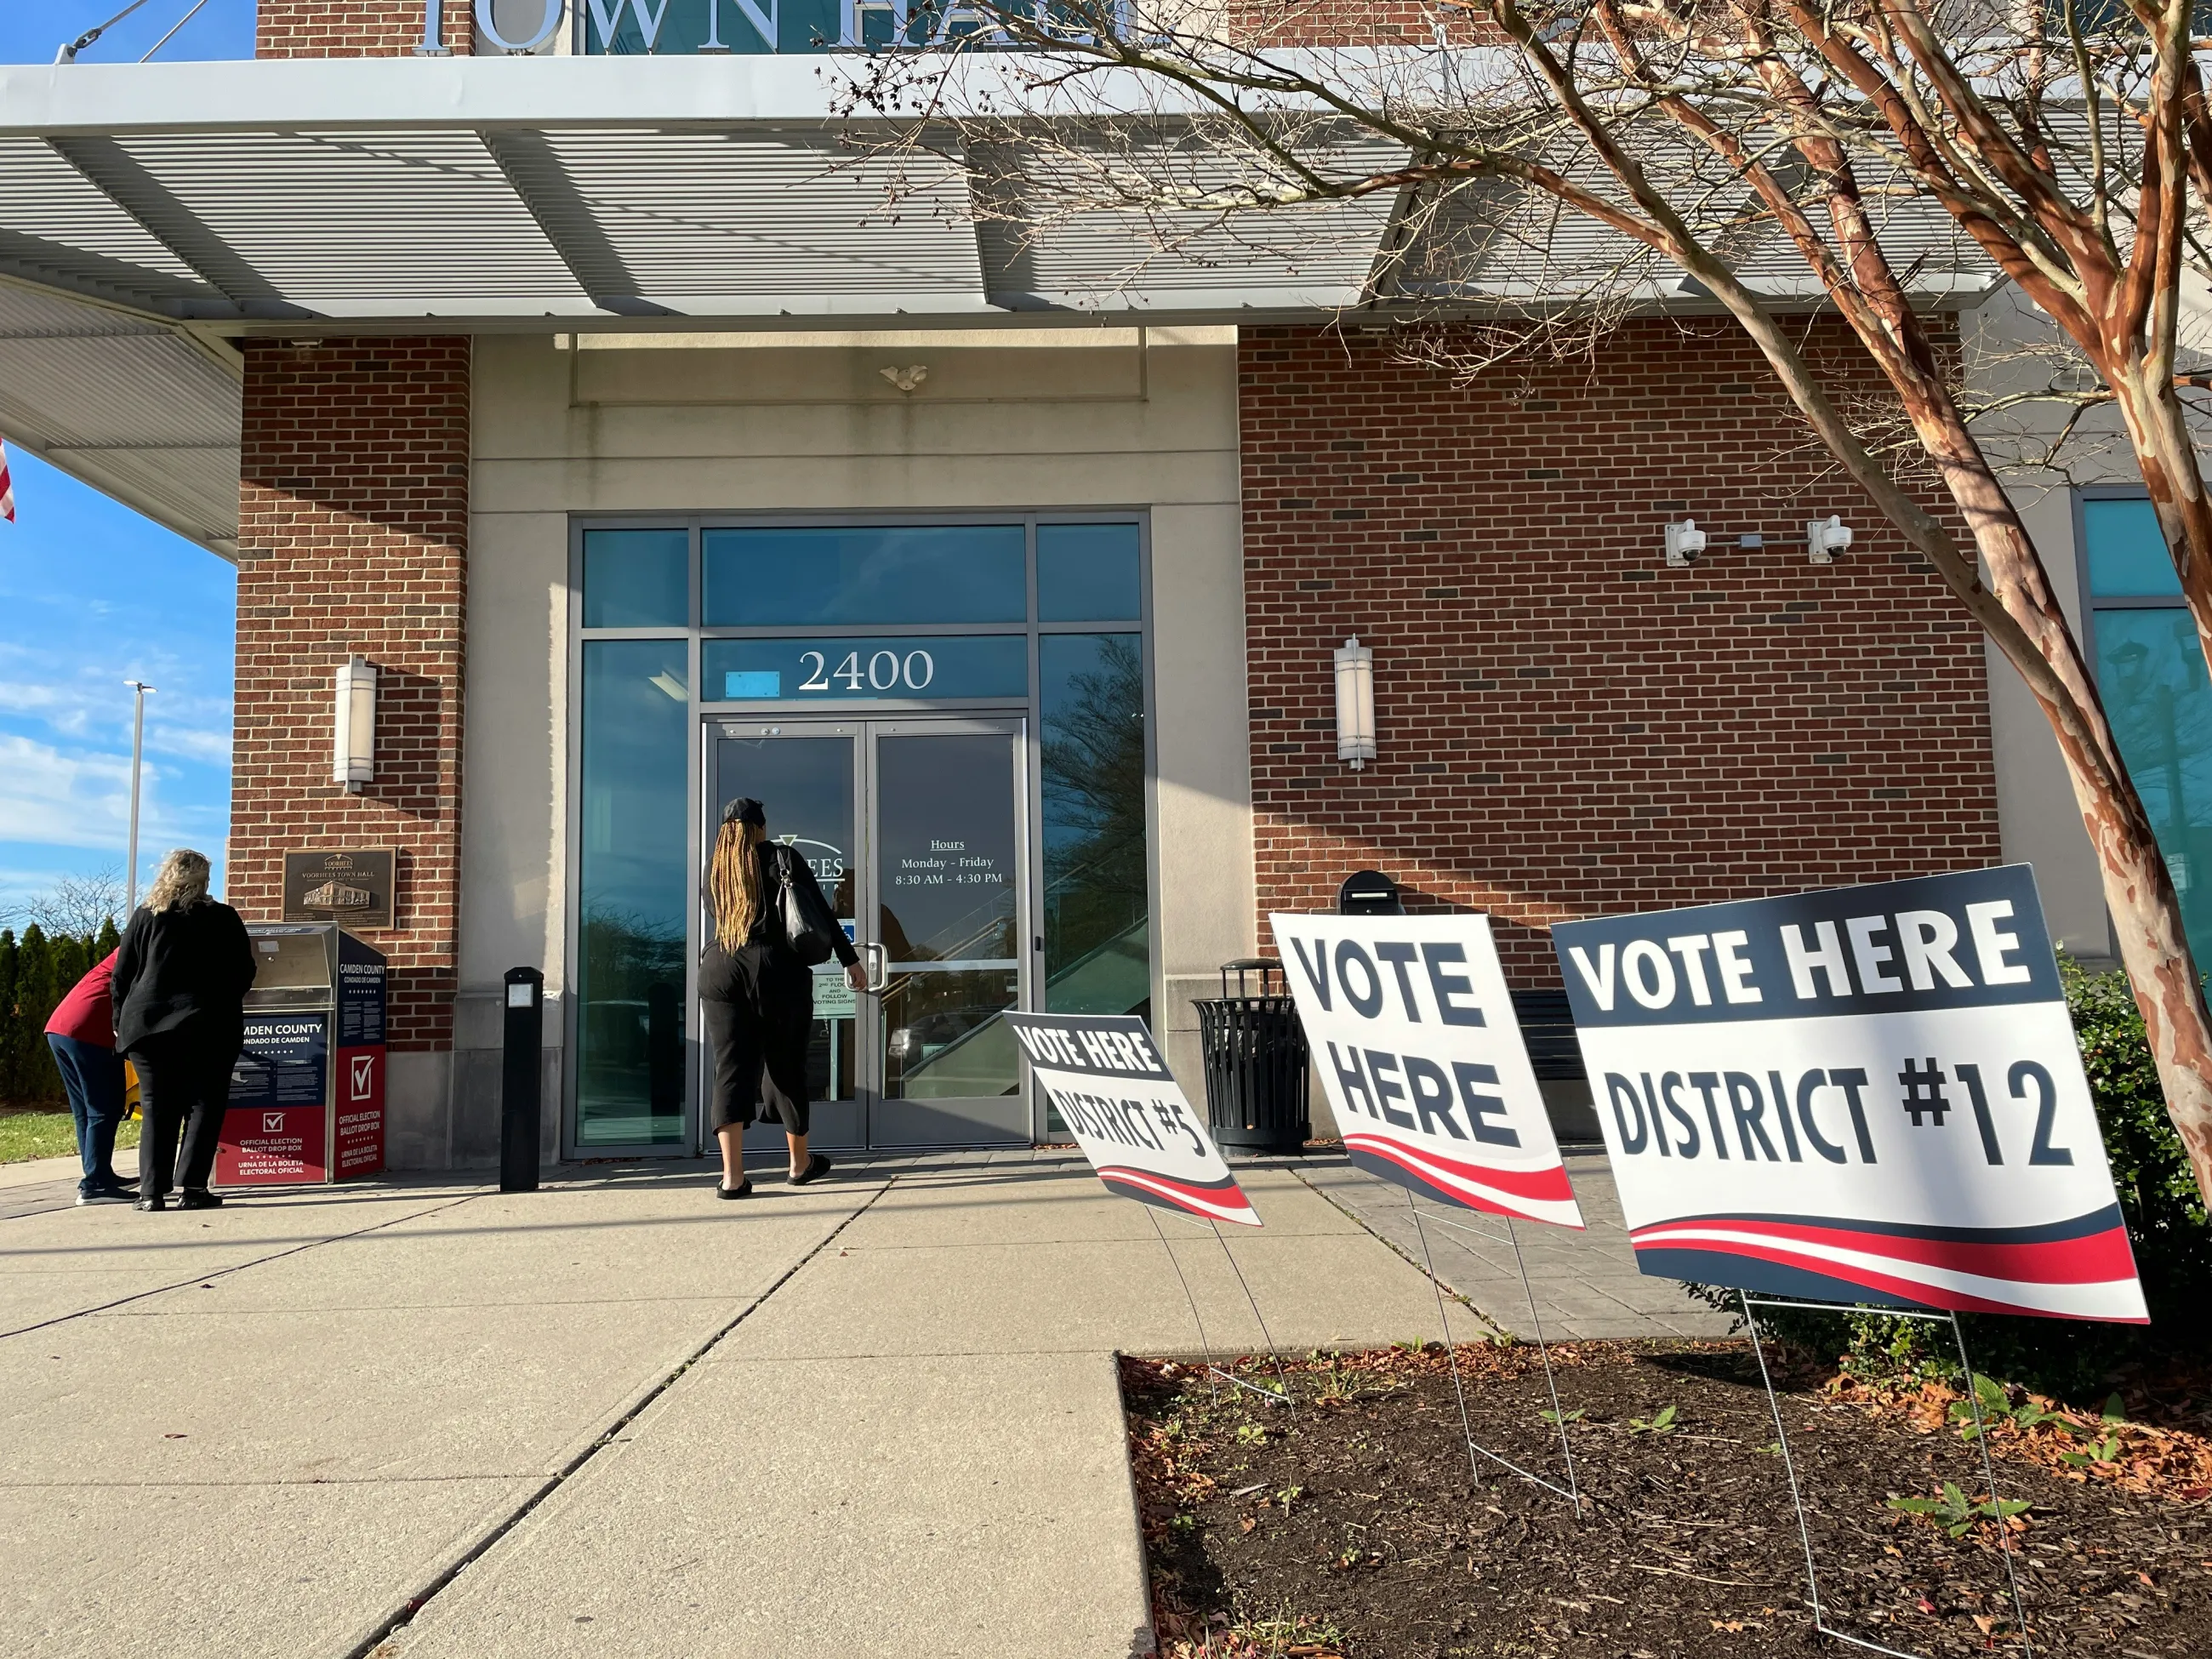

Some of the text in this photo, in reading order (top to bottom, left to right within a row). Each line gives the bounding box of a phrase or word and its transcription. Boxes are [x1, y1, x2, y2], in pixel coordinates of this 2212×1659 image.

[798, 650, 934, 690] 2400
[931, 840, 965, 850] Hours
[901, 858, 947, 869] Monday
[959, 857, 994, 869] Friday
[895, 875, 921, 885] 8:30
[923, 875, 944, 884] AM
[955, 874, 981, 883] 4:30
[984, 873, 1002, 882] PM
[1569, 899, 2032, 1011] VOTE HERE
[340, 964, 385, 975] CAMDEN COUNTY
[1290, 937, 1488, 1028] VOTE
[243, 1023, 322, 1035] MDEN COUNTY
[1012, 1024, 1162, 1072] VOTE HERE
[1326, 1040, 1522, 1149] HERE
[339, 1110, 381, 1125] OFFICIAL ELECTION
[1605, 1057, 2075, 1166] DISTRICT #12
[339, 1121, 380, 1137] BALLOT DROP BOX
[1052, 1088, 1206, 1158] DISTRICT #5
[341, 1149, 353, 1158] URNA
[341, 1157, 364, 1167] ELECTORAL
